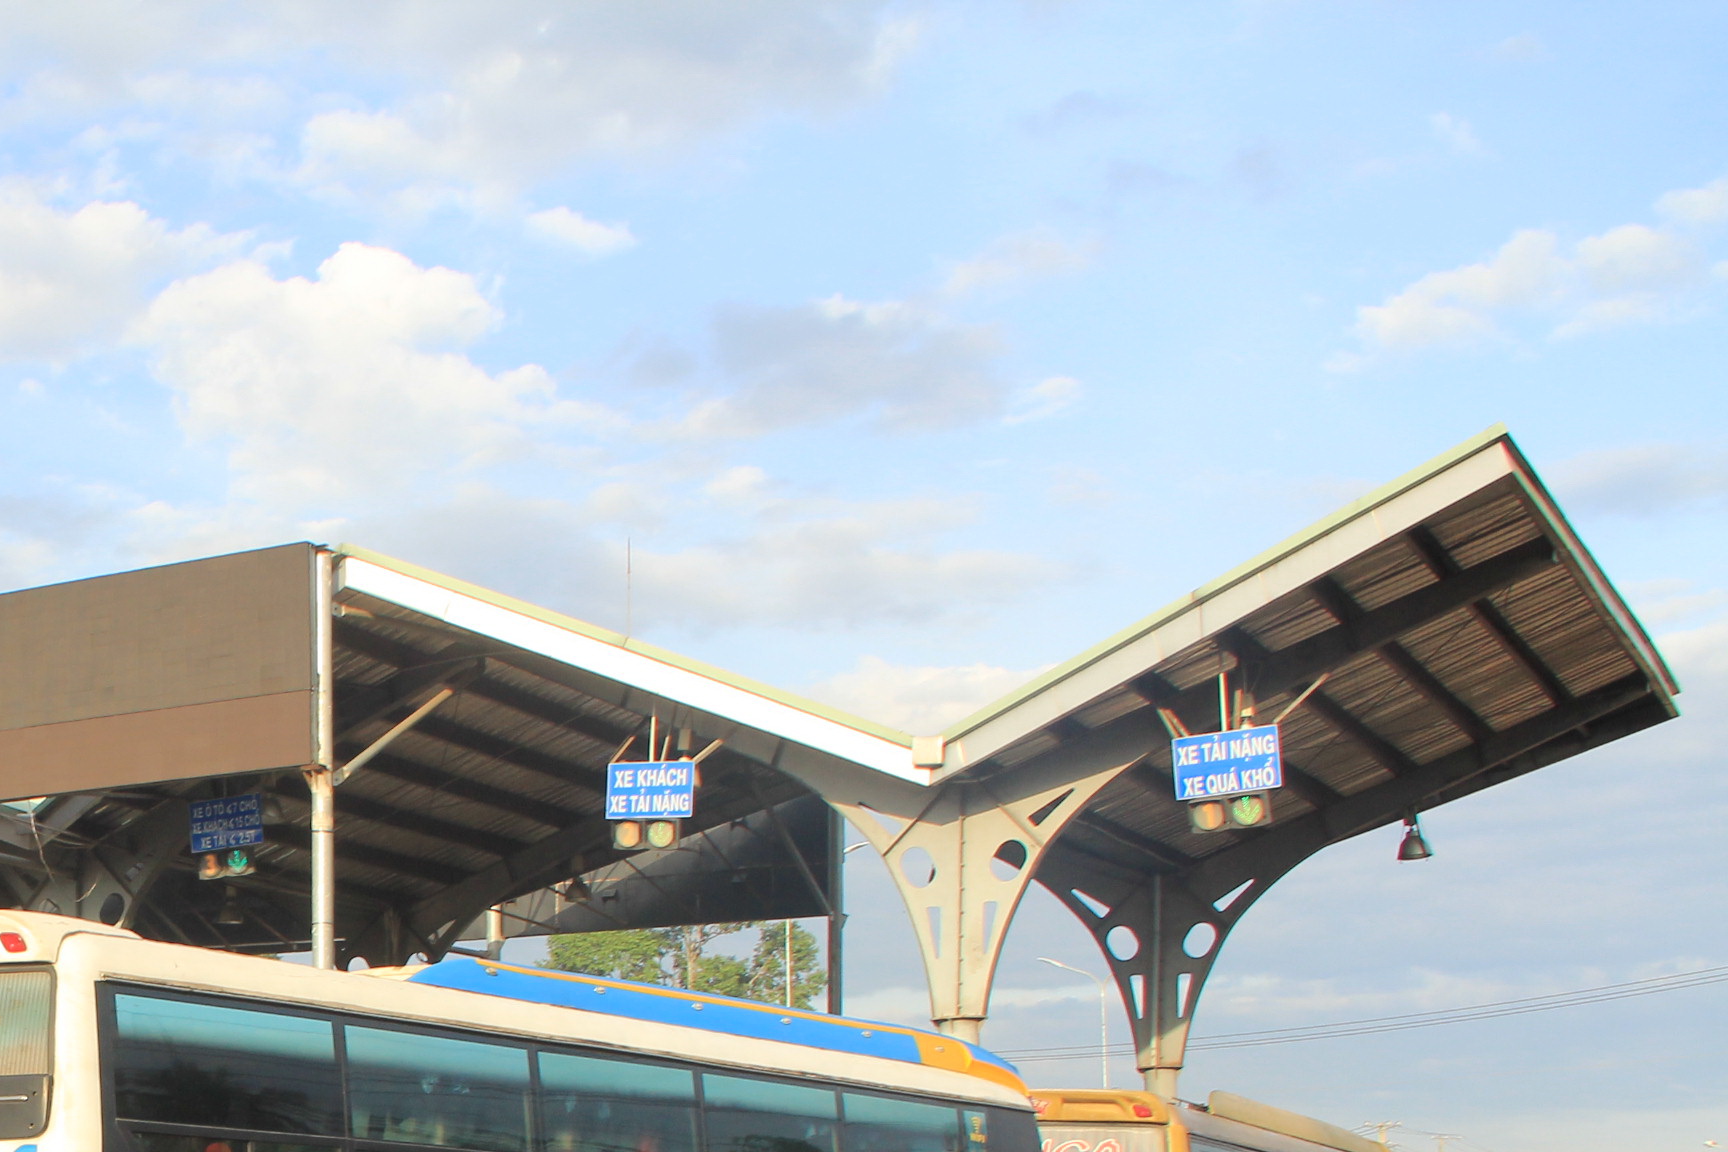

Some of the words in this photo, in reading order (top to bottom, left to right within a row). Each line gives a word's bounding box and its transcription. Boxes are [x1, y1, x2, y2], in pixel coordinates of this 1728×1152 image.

[1177, 745, 1200, 766] XE
[1201, 735, 1227, 762] TẢI
[1229, 733, 1276, 762] NẶNG
[614, 770, 633, 788] XE
[637, 764, 687, 787] KHÁCH
[1183, 775, 1206, 797] XE
[1206, 767, 1240, 794] QUÁ
[1241, 756, 1275, 789] KHỔ
[609, 795, 627, 813] XE
[629, 788, 650, 813] TẢI
[653, 790, 689, 816] NẶNG
